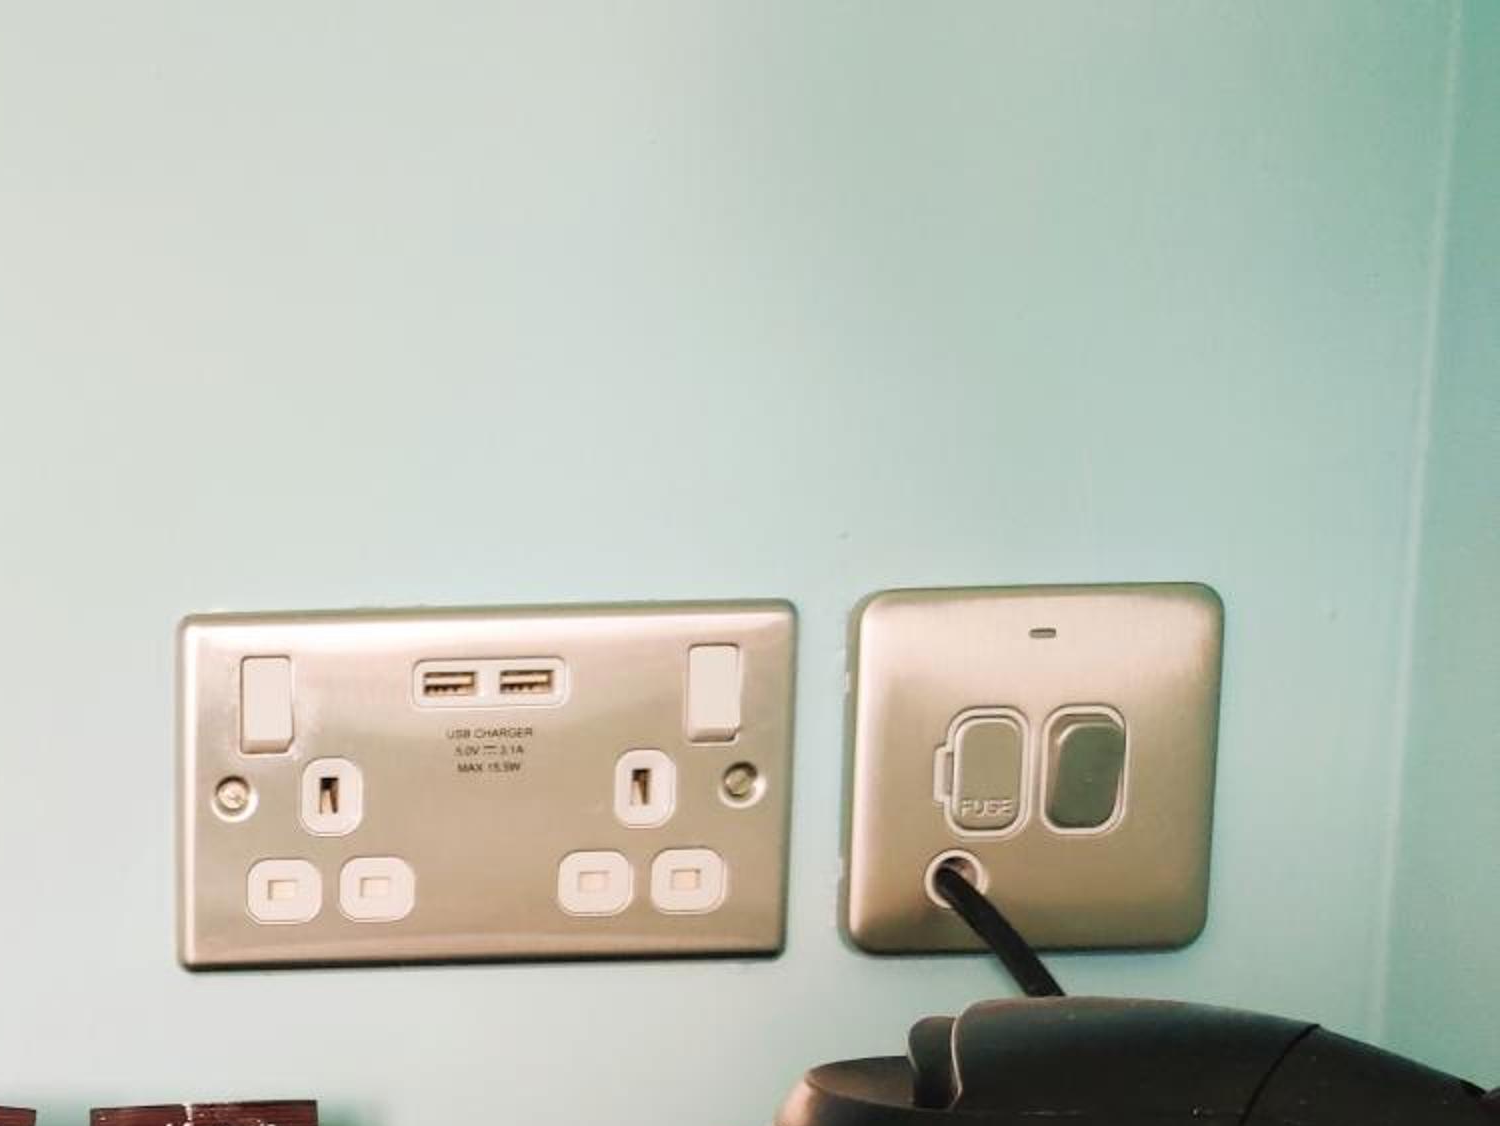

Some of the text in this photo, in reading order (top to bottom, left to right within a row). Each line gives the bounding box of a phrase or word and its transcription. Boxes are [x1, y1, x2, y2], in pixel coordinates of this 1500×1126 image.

[444, 727, 533, 739] USB CHARGER
[961, 799, 1013, 817] FUSE
